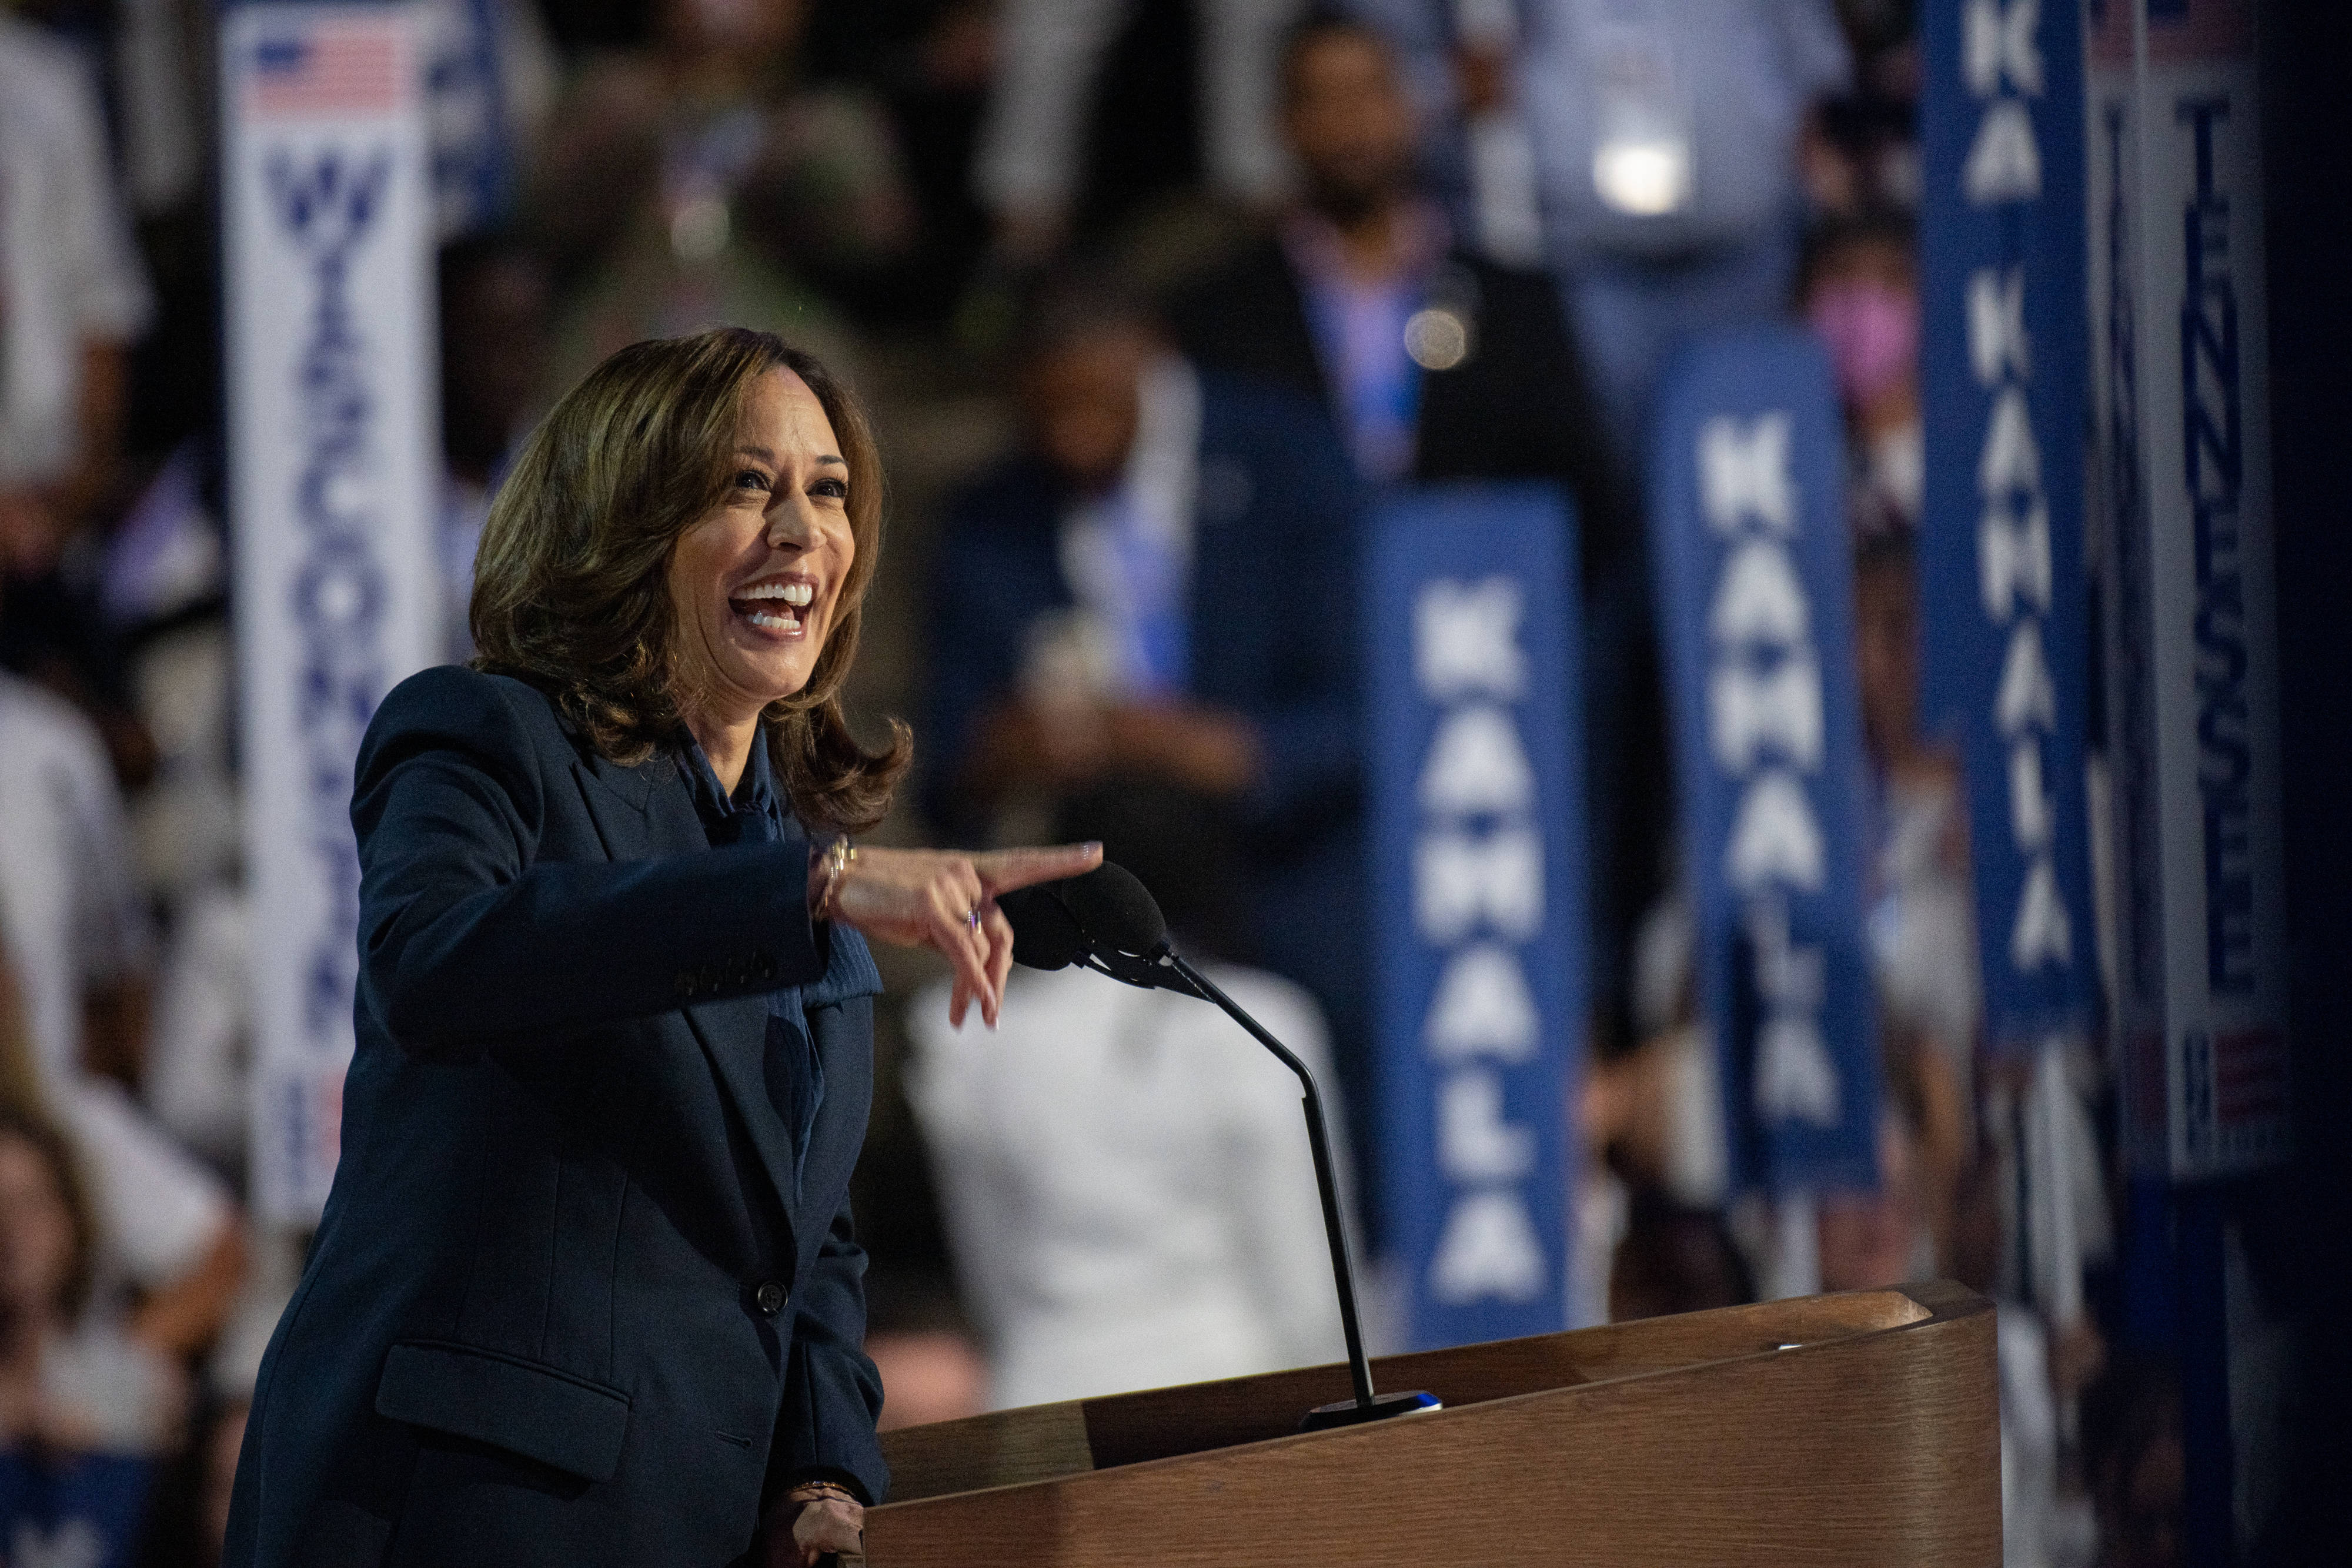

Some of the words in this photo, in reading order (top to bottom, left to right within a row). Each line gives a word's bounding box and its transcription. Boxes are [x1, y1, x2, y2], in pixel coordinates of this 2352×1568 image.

[1696, 412, 1840, 1124] KAMALA
[1966, 262, 2074, 970] KAMALA
[2176, 94, 2255, 994] TENNESSEE
[1416, 576, 1543, 1303] KAMALA
